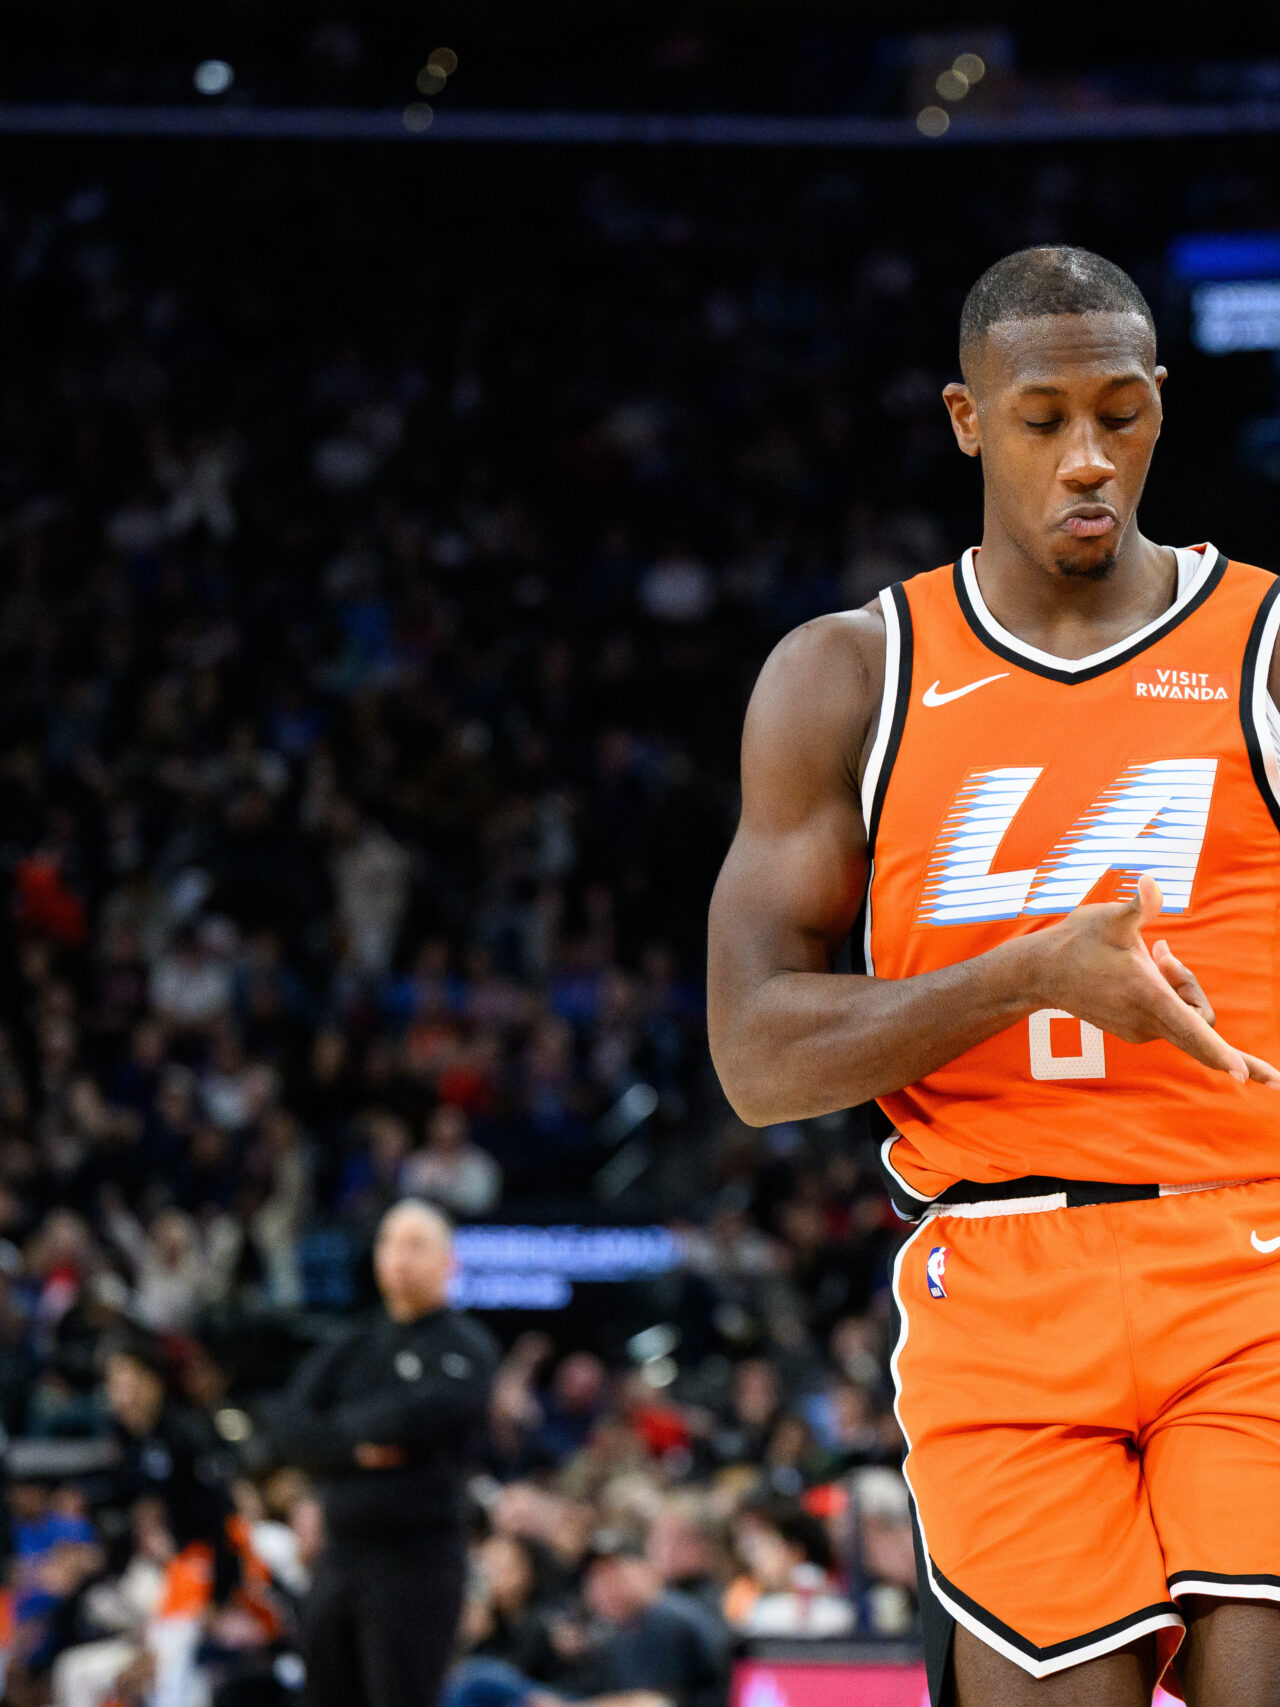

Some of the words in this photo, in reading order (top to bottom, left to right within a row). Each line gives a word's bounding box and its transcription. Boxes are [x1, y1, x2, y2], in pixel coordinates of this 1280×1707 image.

[1156, 669, 1209, 686] VISIT
[1136, 682, 1229, 701] RWANDA
[915, 758, 1219, 926] LA
